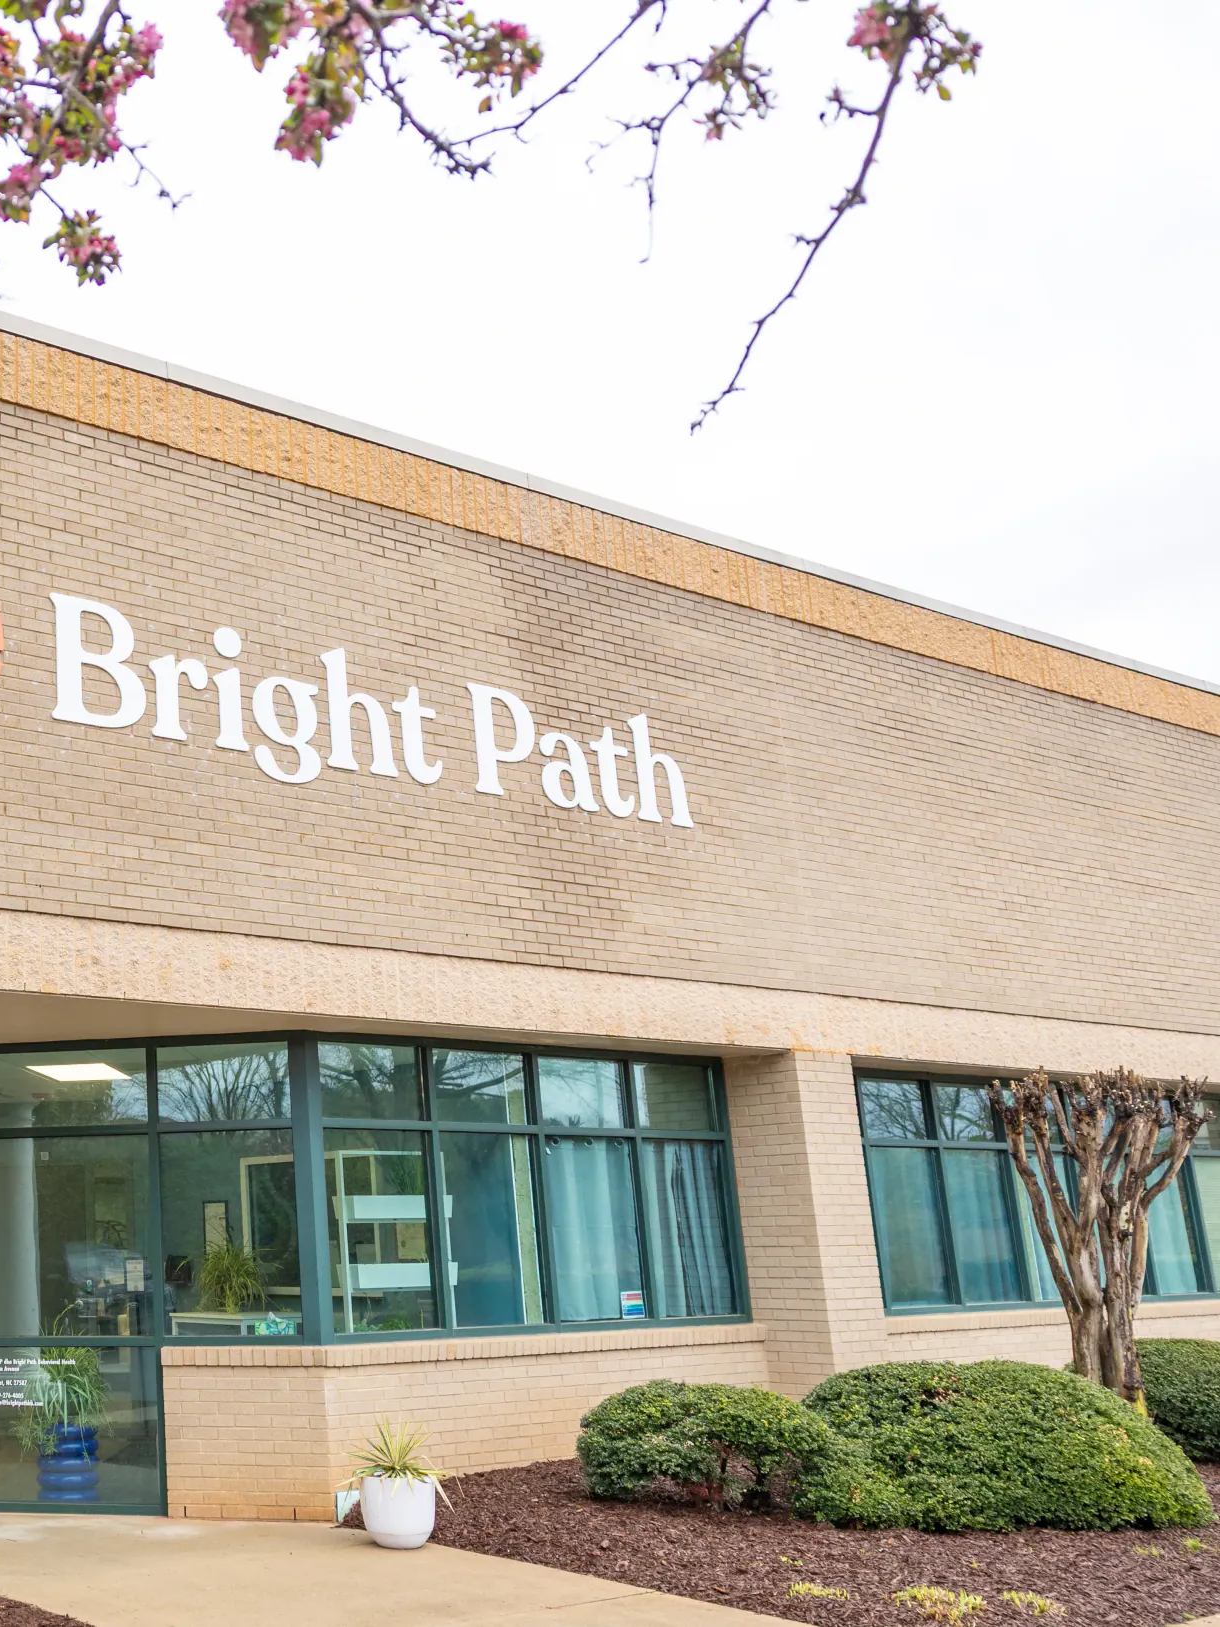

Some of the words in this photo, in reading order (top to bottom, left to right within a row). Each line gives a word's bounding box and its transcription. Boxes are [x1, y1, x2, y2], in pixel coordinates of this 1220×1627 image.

[49, 592, 444, 786] Bright
[466, 682, 693, 829] Path
[13, 1358, 26, 1366] Bright
